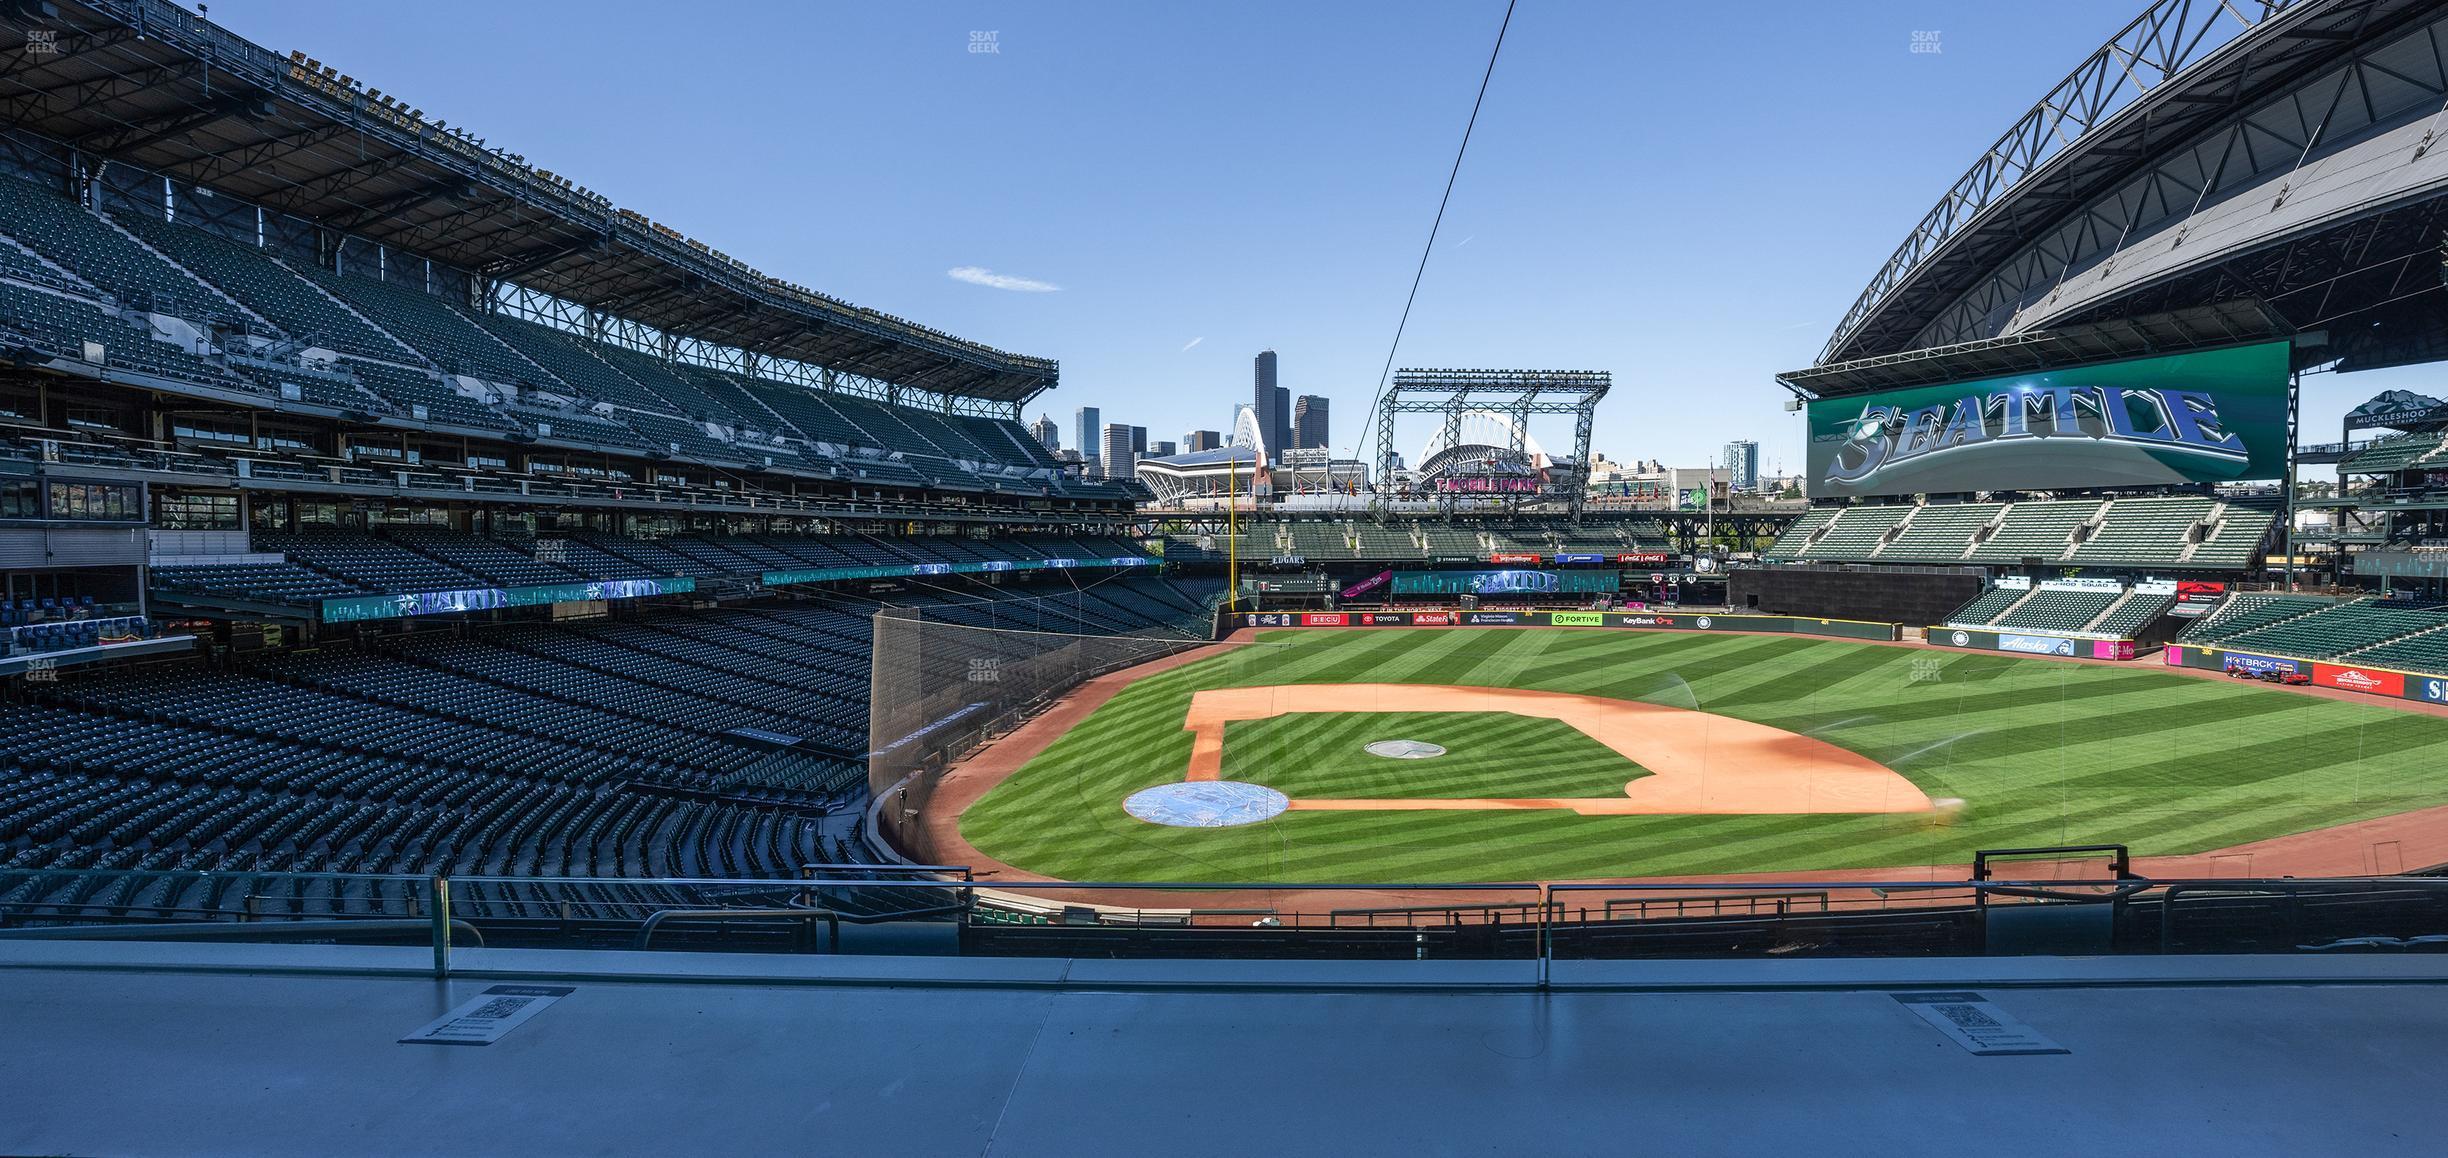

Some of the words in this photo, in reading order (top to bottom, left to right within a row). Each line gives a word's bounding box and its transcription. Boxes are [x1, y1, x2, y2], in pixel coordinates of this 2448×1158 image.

[1825, 386, 2249, 486] SEATTLE
[1501, 479, 1537, 491] PARK
[2002, 637, 2048, 652] Alaska
